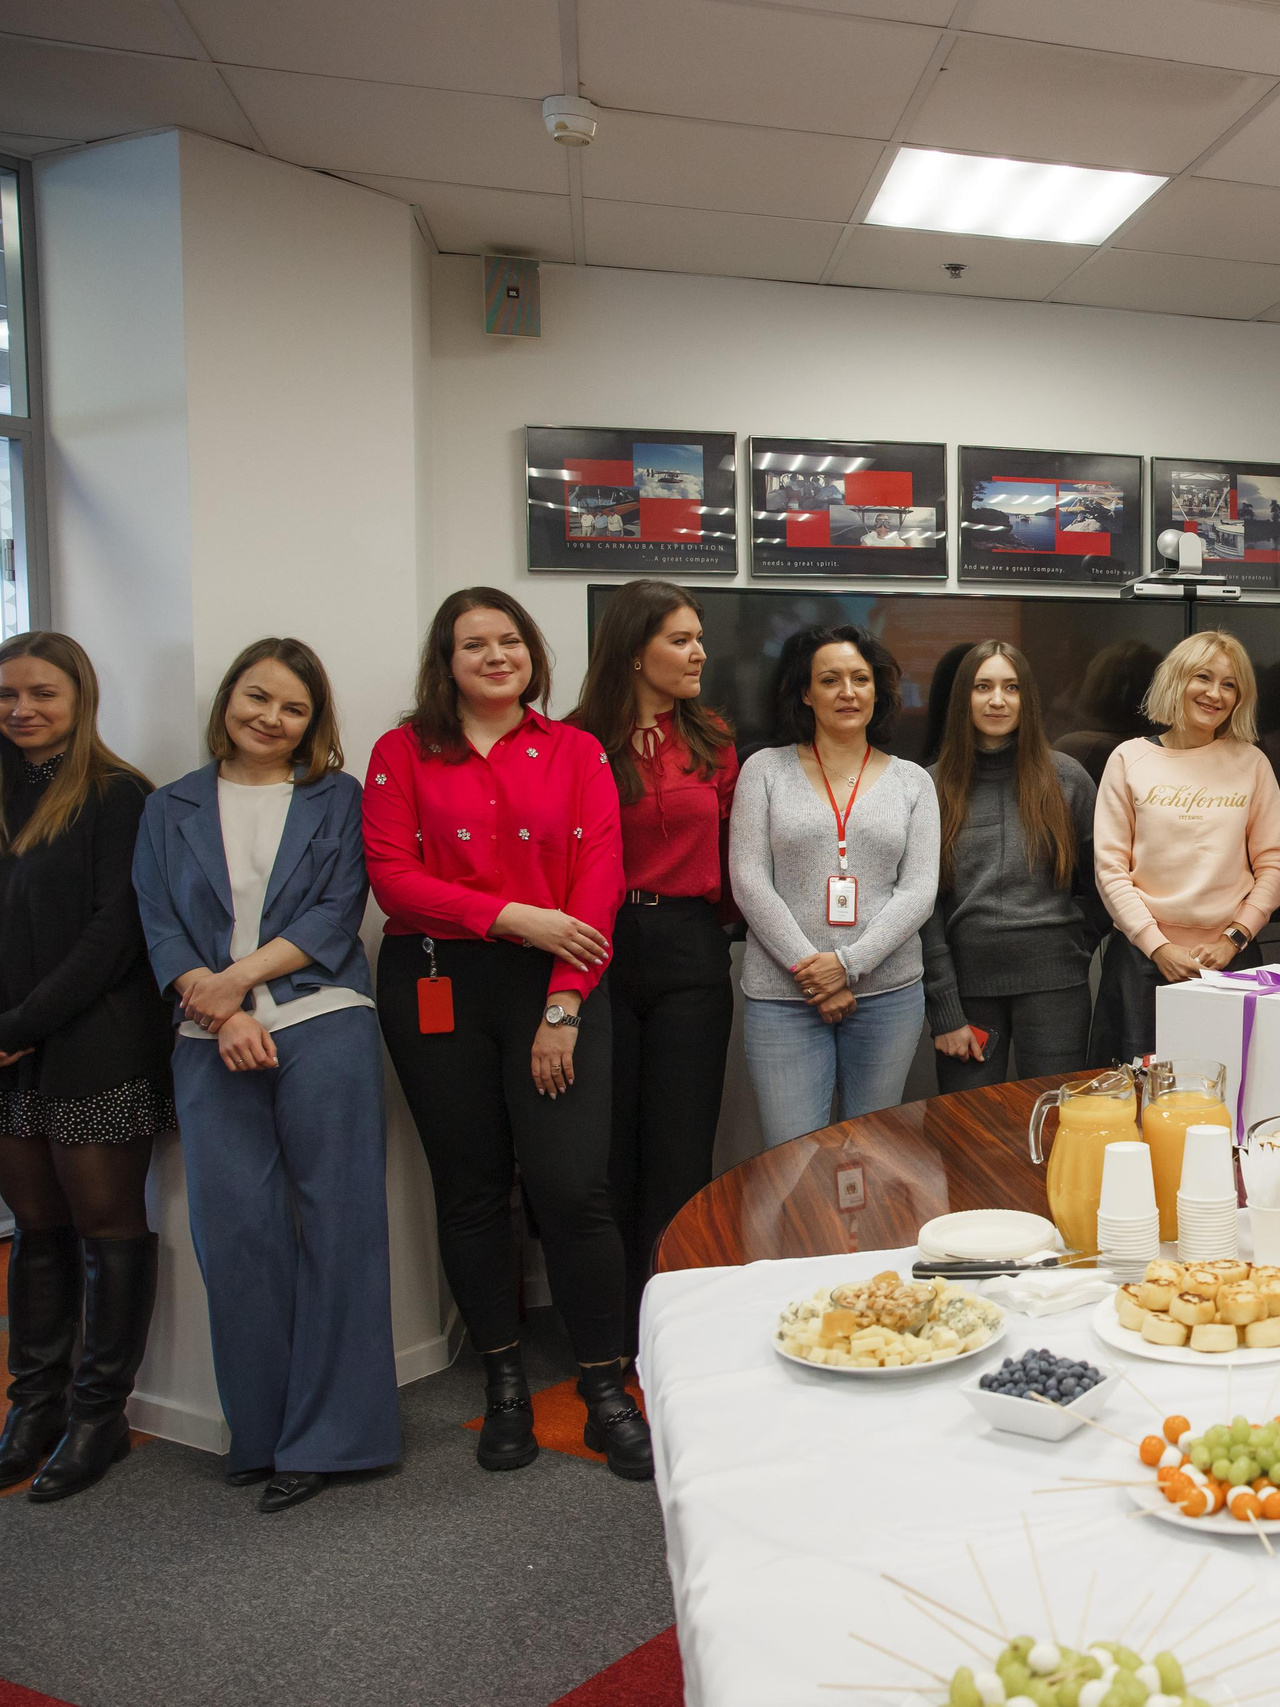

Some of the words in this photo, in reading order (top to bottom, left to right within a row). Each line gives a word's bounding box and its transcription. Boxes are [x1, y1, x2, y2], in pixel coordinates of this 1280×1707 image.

[660, 543, 725, 551] EXPEDITION
[816, 560, 840, 568] spirit.
[1011, 565, 1031, 573] great
[1105, 568, 1121, 576] only
[1133, 784, 1248, 814] Sochifornia
